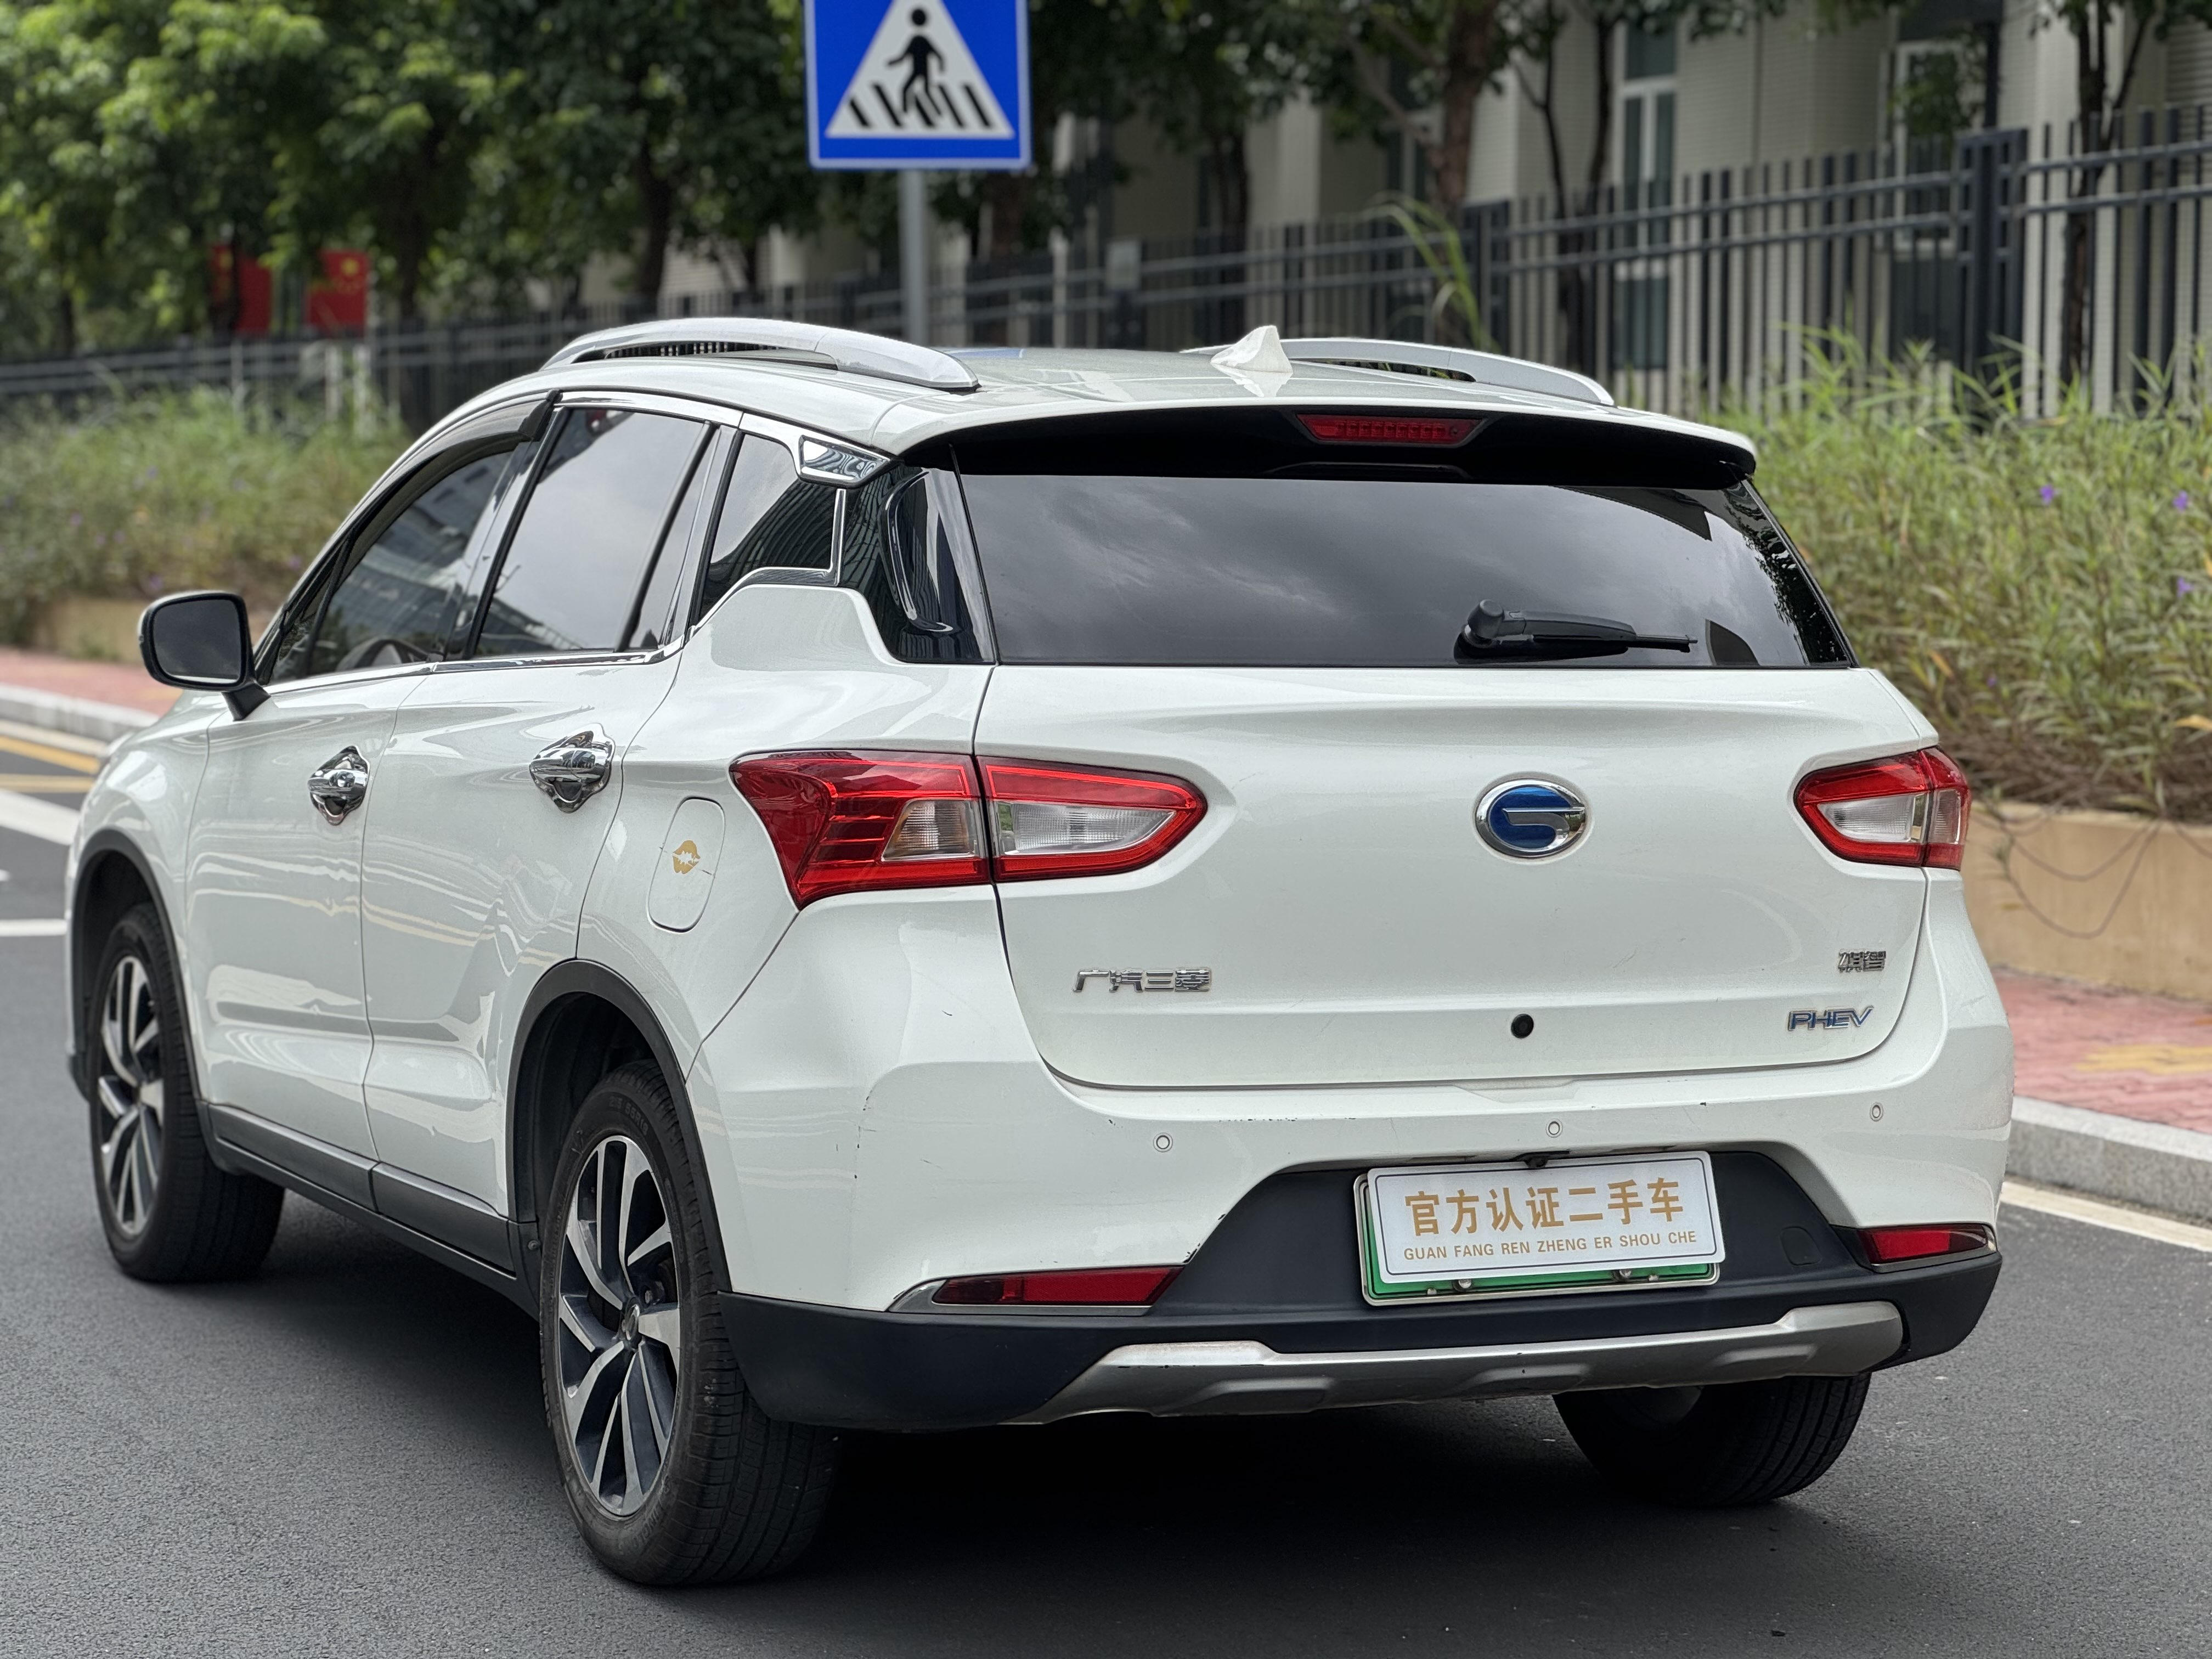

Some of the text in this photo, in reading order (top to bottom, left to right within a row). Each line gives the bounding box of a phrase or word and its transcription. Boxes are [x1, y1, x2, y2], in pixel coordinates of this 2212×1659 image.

[1073, 968, 1211, 992] 广汽三菱
[1787, 1005, 1874, 1031] PHEV
[1404, 1177, 1684, 1237] 官方认证二手车
[1404, 1231, 1696, 1261] GUAN FANG REN ZHENG ER SHOU CHE
